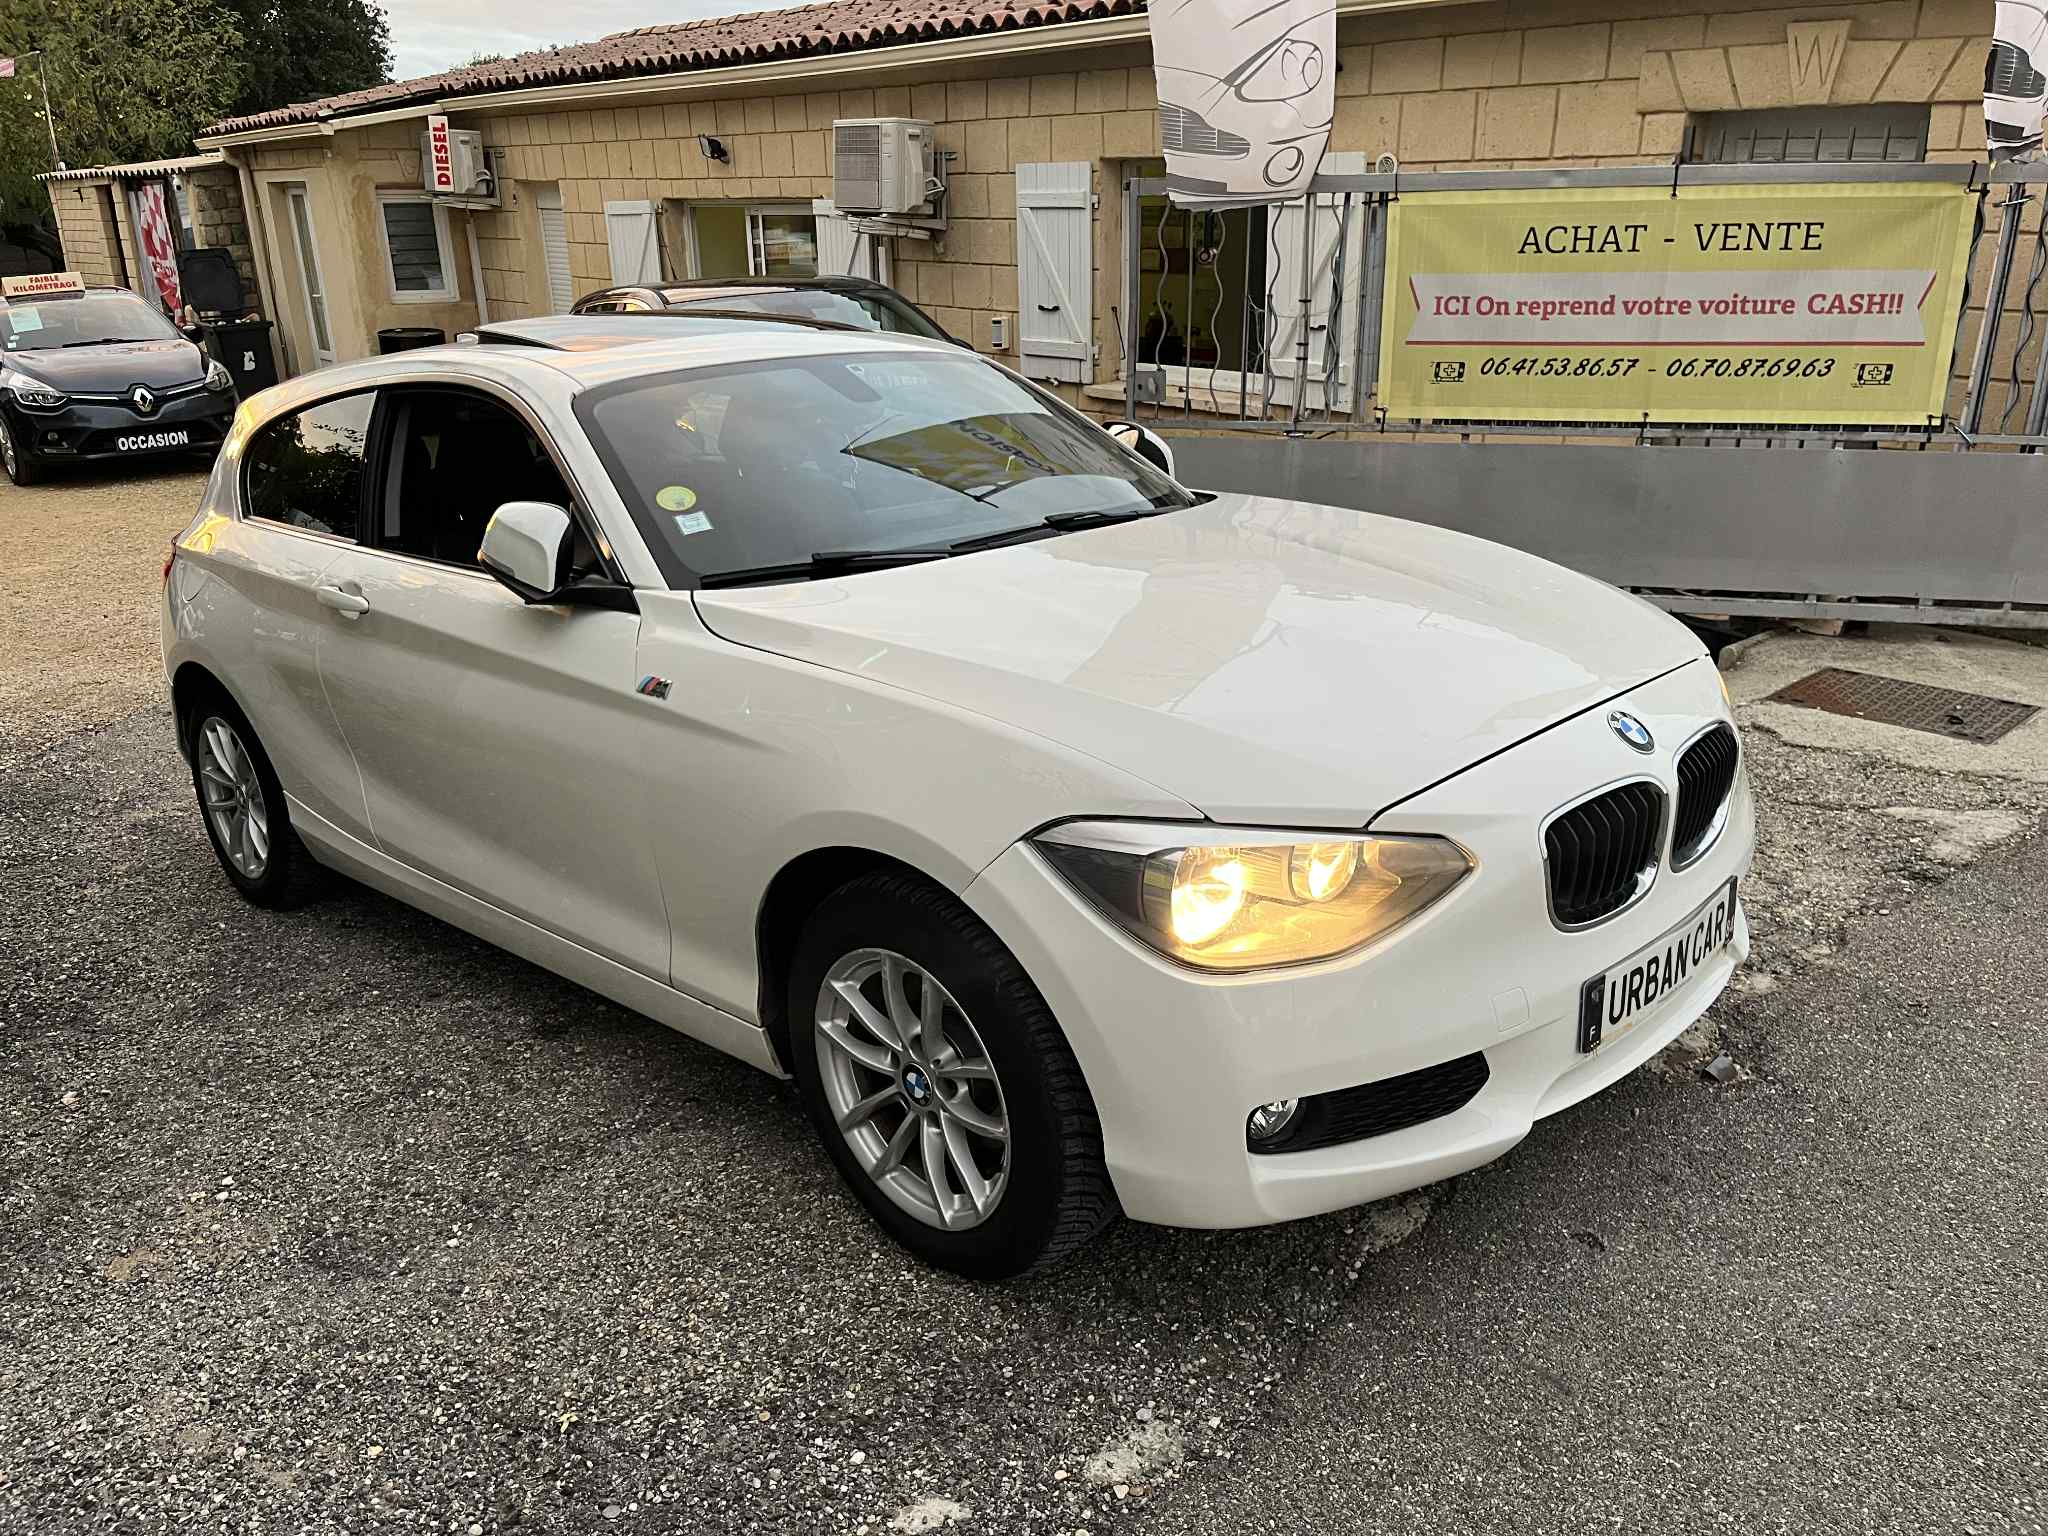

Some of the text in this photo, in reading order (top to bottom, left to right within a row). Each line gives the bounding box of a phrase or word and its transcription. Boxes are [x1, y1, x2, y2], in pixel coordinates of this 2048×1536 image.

[432, 122, 452, 186] DIESEL
[1517, 224, 1648, 254] ACHAT
[1693, 222, 1825, 252] VENTE
[12, 280, 78, 293] KILOMETRAGE
[28, 274, 60, 285] FAIBLE
[1433, 293, 1905, 321] ICI On reprend votre voiture CASH!!
[1480, 357, 1640, 377] 06.41.53.86.57
[1665, 358, 1836, 378] 06.70.87.69.63
[117, 430, 189, 451] OCCASION
[1608, 900, 1726, 1026] URBAN CAR
